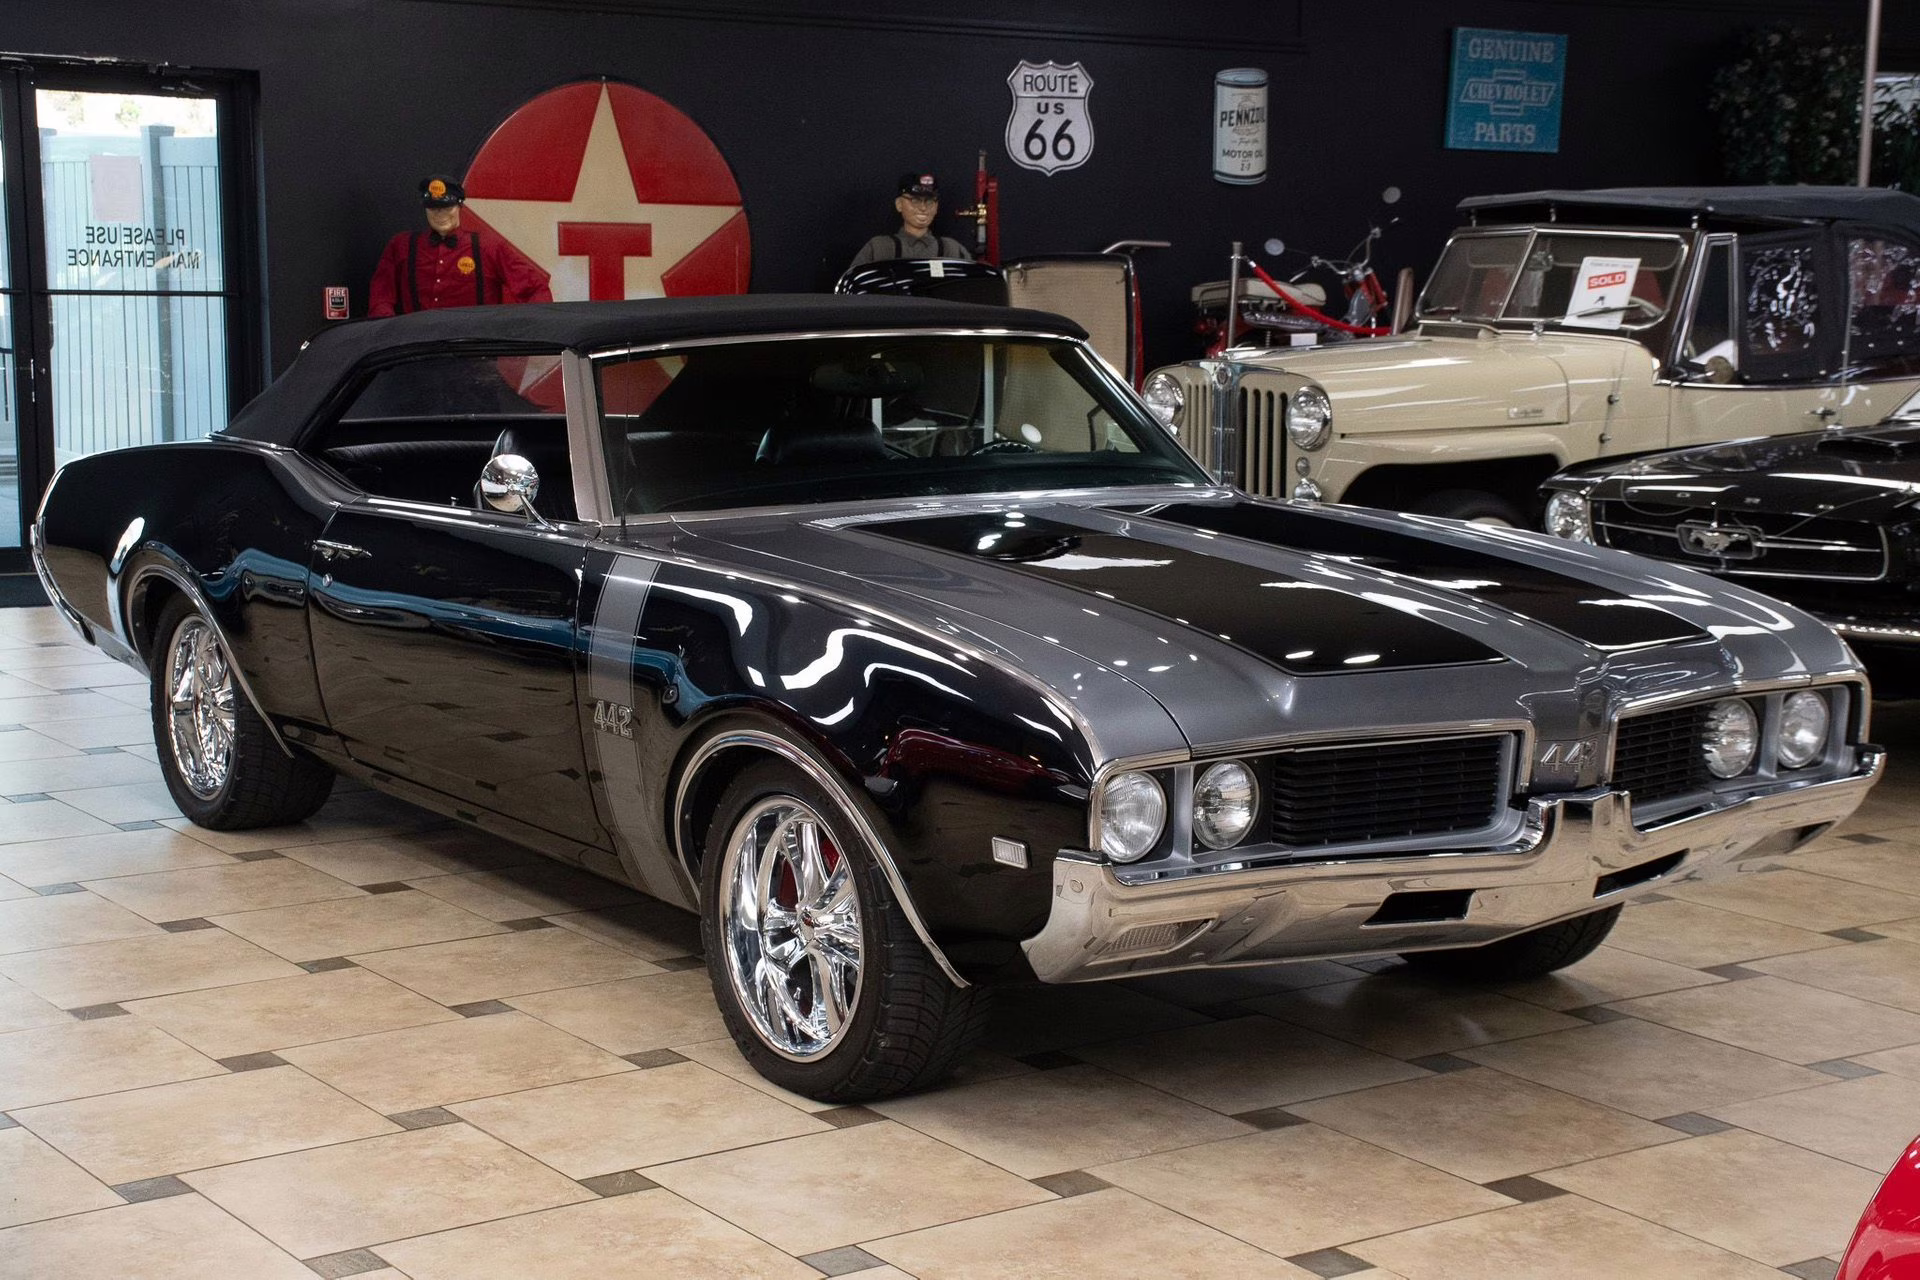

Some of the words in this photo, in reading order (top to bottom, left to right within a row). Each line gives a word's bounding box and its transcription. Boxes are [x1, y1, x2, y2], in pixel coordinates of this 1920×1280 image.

[1468, 38, 1554, 63] GENUINE
[1023, 74, 1078, 93] ROUTE
[1467, 82, 1551, 103] CHEVROLET
[1036, 102, 1065, 115] US
[1024, 118, 1075, 161] 66
[1474, 122, 1538, 144] PARTS
[1222, 149, 1253, 159] MOTOR
[1589, 273, 1625, 287] SOLD
[328, 288, 346, 297] FIRE
[594, 700, 633, 739] 442
[1540, 738, 1599, 773] 442
